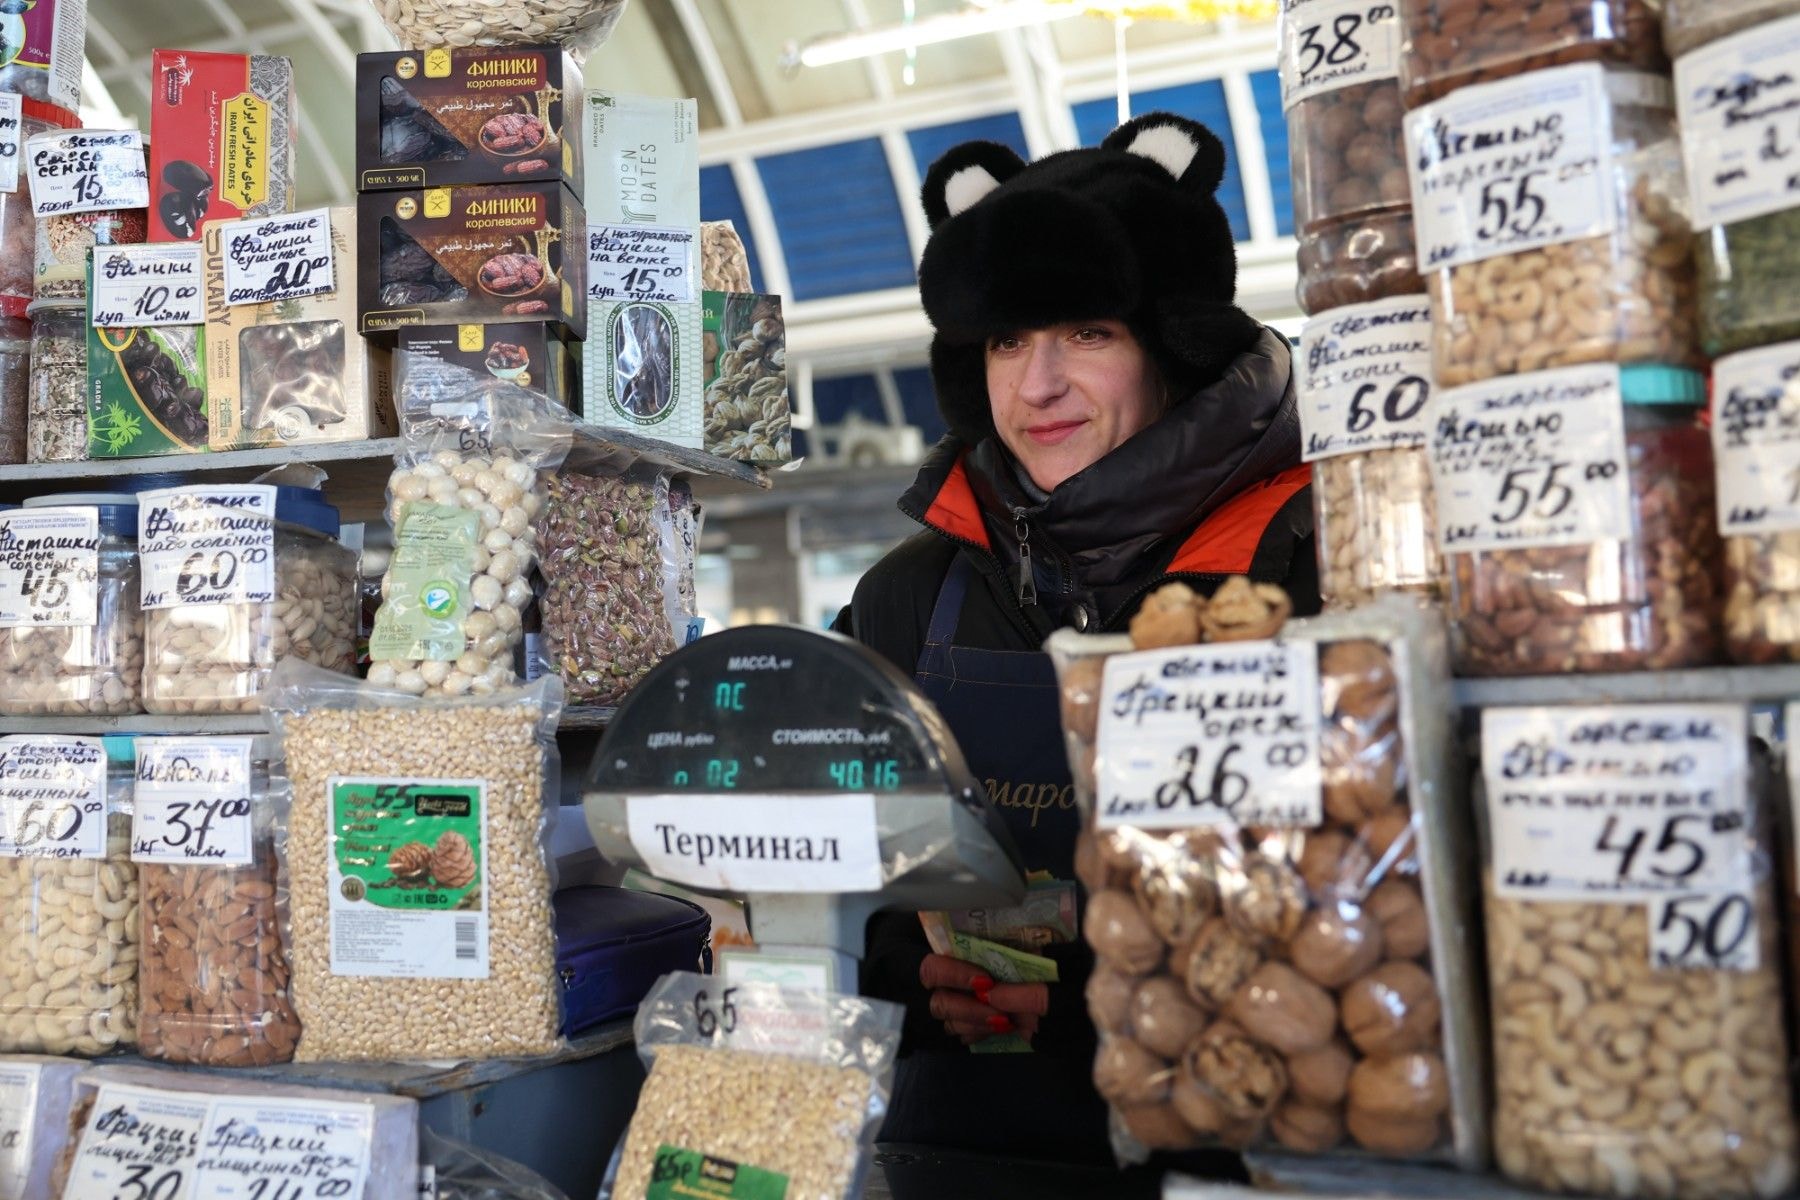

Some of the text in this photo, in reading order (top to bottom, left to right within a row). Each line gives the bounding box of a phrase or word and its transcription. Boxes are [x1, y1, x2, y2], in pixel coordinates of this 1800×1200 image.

[466, 58, 538, 77] ФИНИКИ
[1299, 14, 1361, 78] 38
[466, 77, 537, 91] королевские
[228, 111, 238, 190] IRAN FRESH DATES
[640, 143, 657, 203] DATES
[72, 173, 104, 204] 15
[465, 197, 537, 216] ФИНИКИ
[1476, 170, 1549, 240] 55
[465, 216, 537, 230] королевские
[101, 255, 193, 279] Финики
[265, 260, 311, 293] 20
[590, 251, 670, 265] на ветке
[620, 267, 660, 293] 15
[134, 286, 169, 317] 10
[1347, 375, 1430, 433] 60
[1492, 462, 1574, 524] 55
[176, 550, 237, 596] 60
[1154, 744, 1249, 810] 26
[14, 801, 83, 847] 60
[163, 798, 221, 851] 37
[655, 824, 841, 866] Терминал
[1595, 813, 1706, 882] 45
[1658, 893, 1752, 965] 50
[694, 986, 739, 1037] 65
